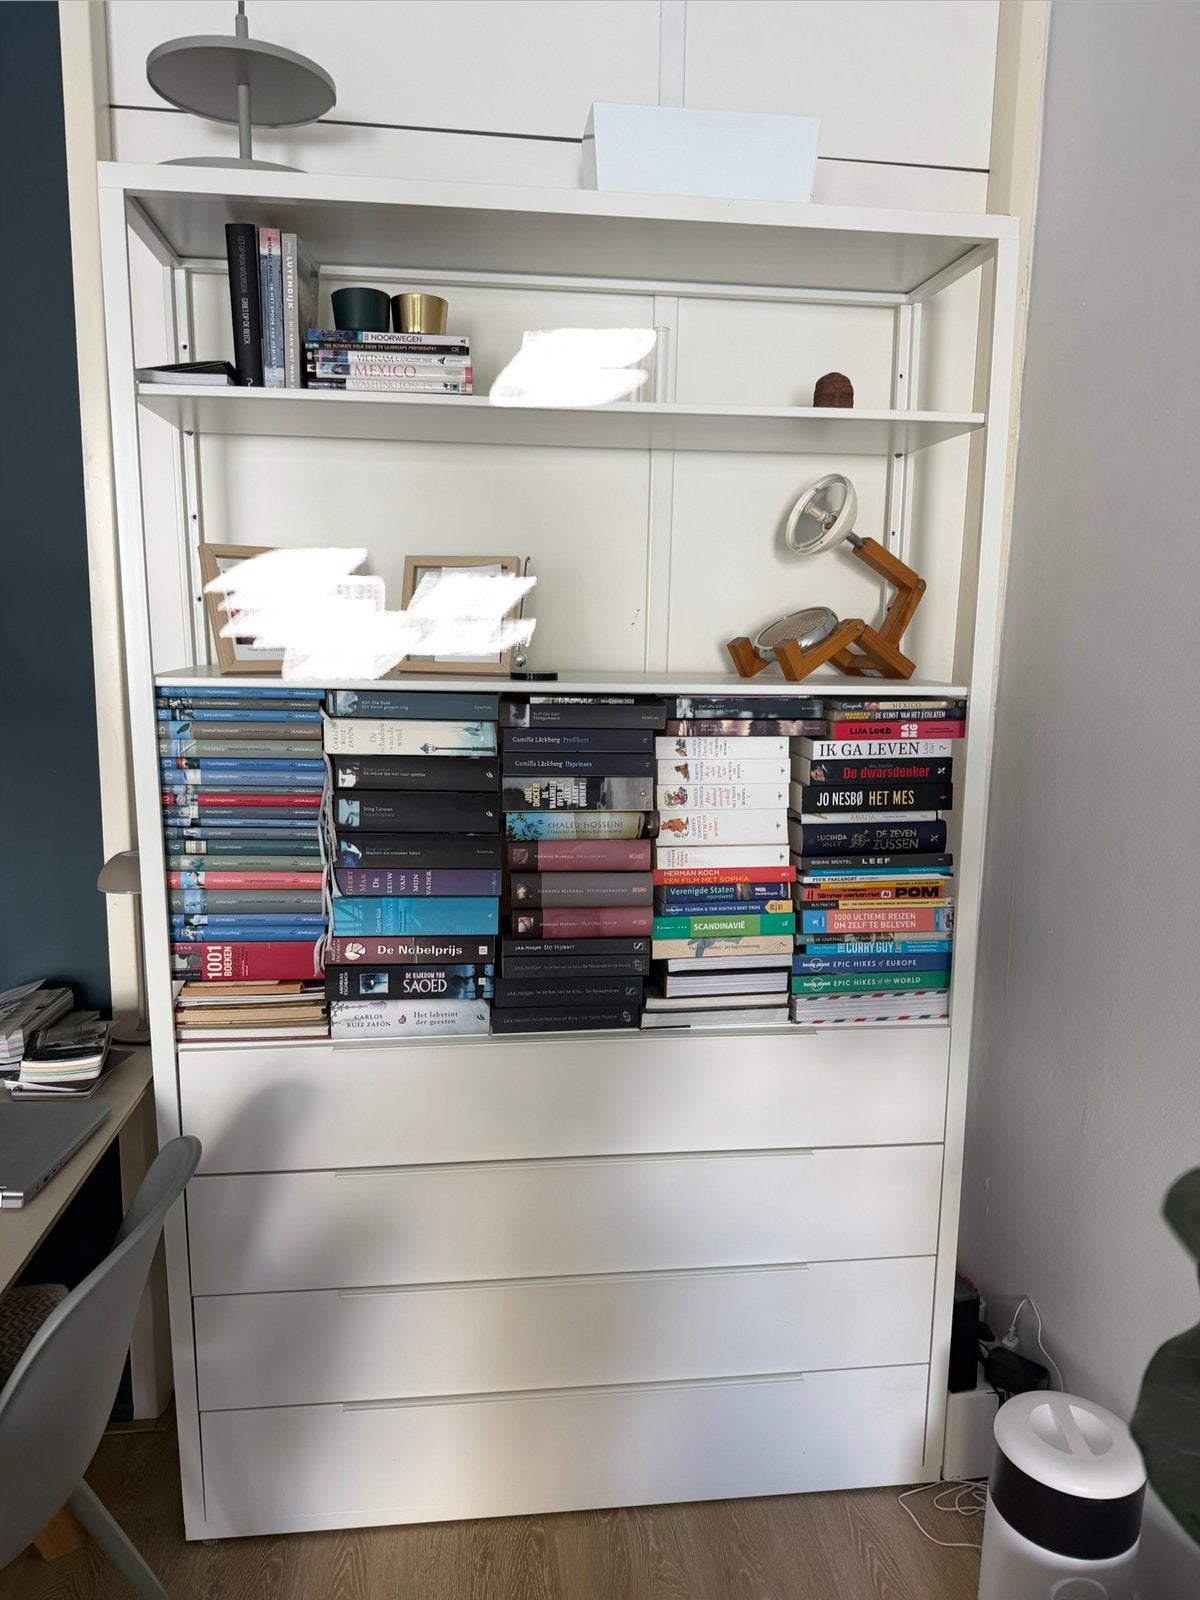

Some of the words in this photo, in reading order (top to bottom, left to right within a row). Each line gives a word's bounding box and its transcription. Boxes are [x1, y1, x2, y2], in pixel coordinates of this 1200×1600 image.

[371, 334, 422, 342] NOORWEGEN
[356, 354, 394, 362] VIETNAM
[354, 364, 416, 378] MEXICO
[369, 732, 376, 742] De
[535, 736, 560, 744] Läckberg
[820, 744, 838, 756] IK
[842, 743, 863, 756] GA
[868, 742, 920, 756] LEVEN
[538, 760, 562, 768] Läckberg
[843, 768, 858, 780] De
[860, 766, 930, 778] dwarsdenker
[542, 790, 549, 798] DE
[816, 792, 829, 806] JO
[832, 790, 864, 806] NESBØ
[868, 790, 890, 806] HET
[892, 790, 914, 804] MES
[584, 820, 623, 828] HOSSEINI
[876, 830, 888, 838] DE
[890, 829, 917, 838] ZEVEN
[872, 838, 919, 850] ZUSSEN
[359, 874, 367, 892] MAK
[372, 876, 380, 888] DE
[670, 886, 708, 896] Verenigde
[895, 886, 940, 898] POM
[694, 920, 745, 930] SCANDINAVIË
[378, 946, 394, 954] De
[398, 946, 463, 957] Nobelprijs
[846, 942, 875, 953] CURRY
[876, 942, 894, 953] GUY
[207, 946, 222, 979] 1001
[224, 946, 232, 976] BOEKEN
[403, 980, 447, 993] SAOED
[430, 1010, 458, 1020] labyrint
[430, 1018, 456, 1028] geesten
